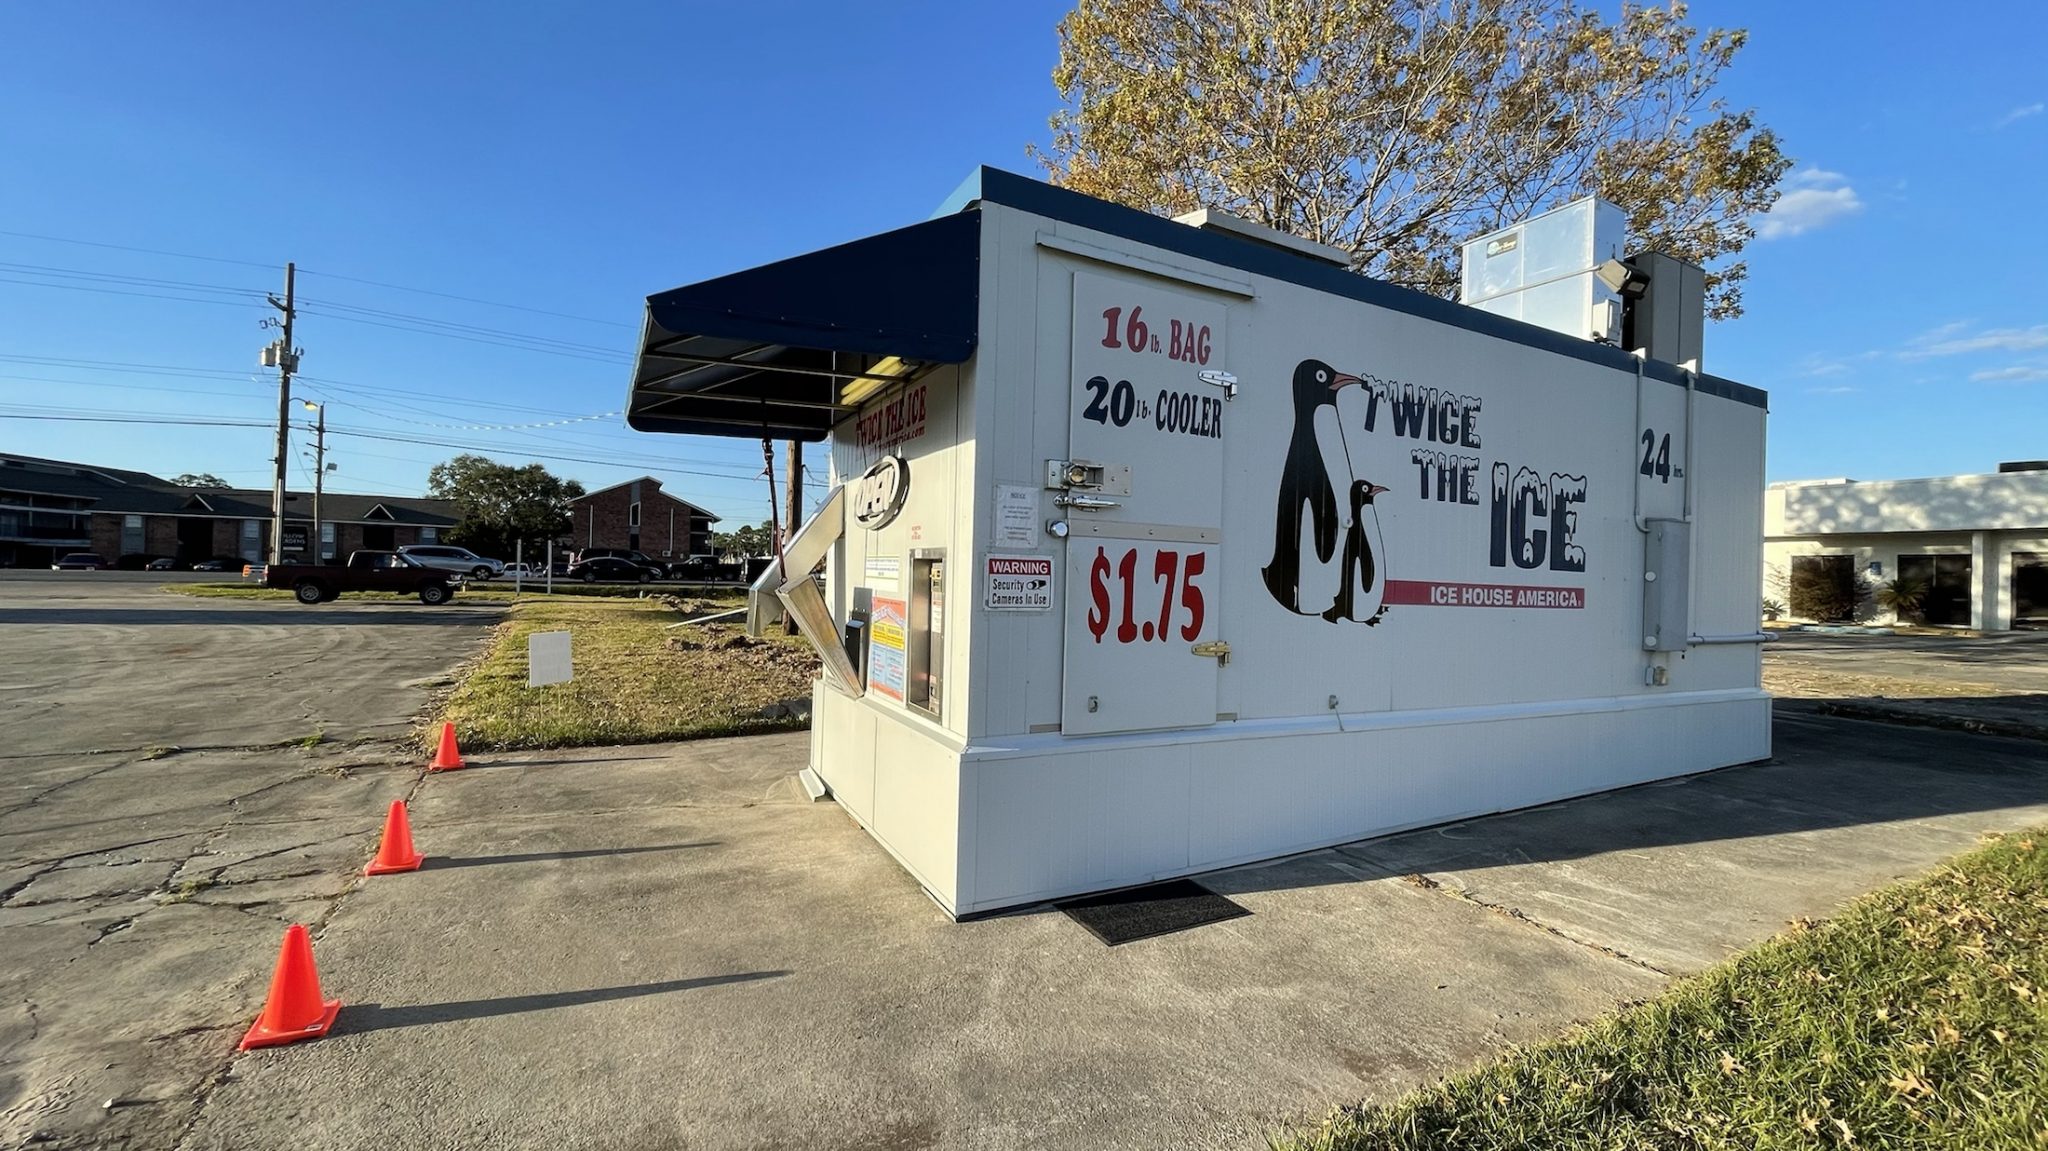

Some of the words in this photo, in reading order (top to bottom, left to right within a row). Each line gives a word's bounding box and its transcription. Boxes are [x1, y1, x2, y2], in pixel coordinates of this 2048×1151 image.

[1101, 305, 1148, 353] 16
[1168, 319, 1211, 366] BAG
[856, 409, 883, 448] TWICE
[885, 397, 905, 437] THE
[906, 385, 927, 428] ICE
[1083, 375, 1136, 428] 20
[1155, 389, 1222, 439] COOLER
[1361, 373, 1482, 449] TWICE
[1640, 427, 1671, 484] 24
[856, 467, 894, 516] OPEN
[1411, 448, 1480, 505] THE
[1490, 461, 1588, 573] ICE
[991, 561, 1049, 574] WARNING
[992, 578, 1025, 592] Security
[1087, 545, 1206, 644] $1.75
[1431, 586, 1458, 604] ICE
[1462, 587, 1513, 606] HOUSE
[992, 592, 1023, 604] Cameras
[1025, 594, 1032, 605] In
[1034, 594, 1047, 605] Use
